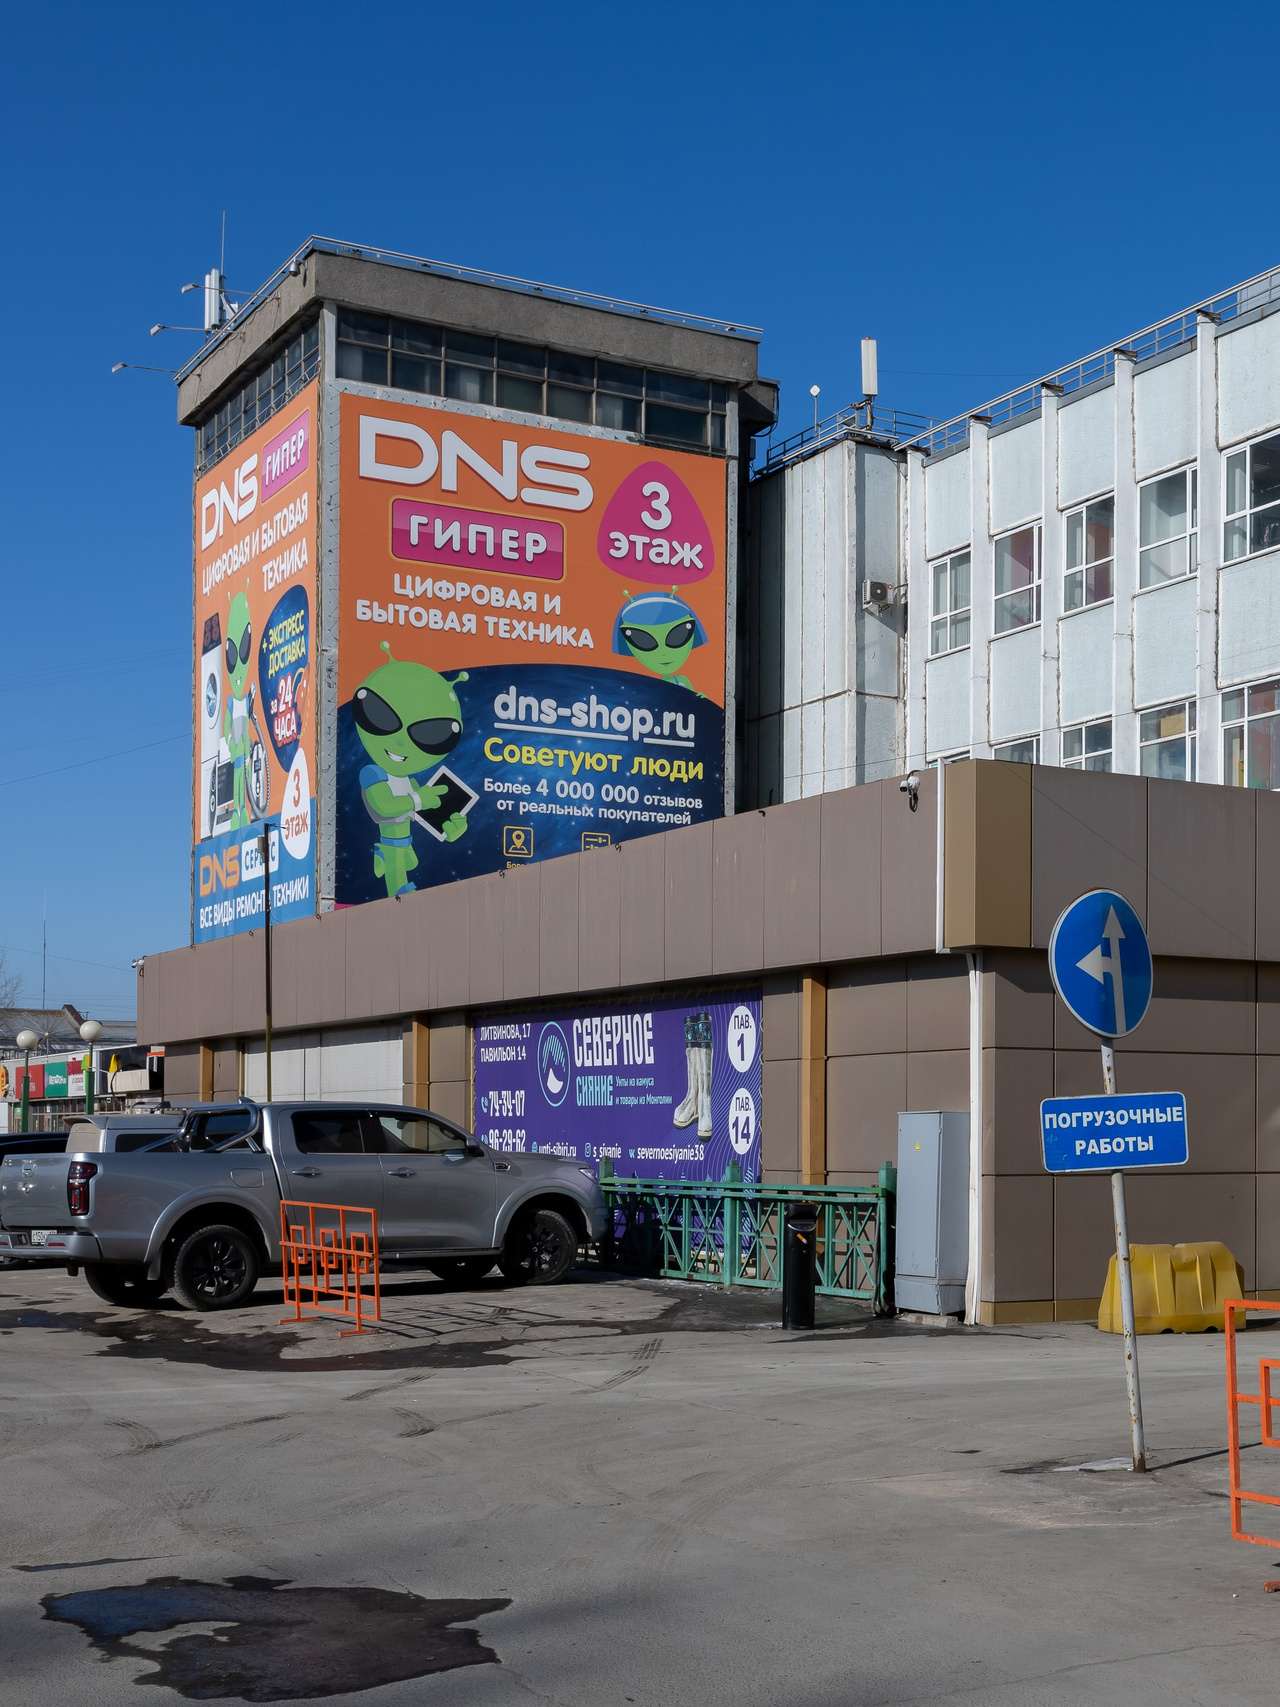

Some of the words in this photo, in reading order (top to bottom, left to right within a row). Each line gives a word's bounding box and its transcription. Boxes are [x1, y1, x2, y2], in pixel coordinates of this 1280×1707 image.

[265, 428, 305, 486] ГИПЕР
[359, 415, 594, 511] DNS
[202, 453, 258, 550] DNS
[640, 481, 672, 530] 3
[202, 534, 250, 596] ЦИФРОВАЯ
[252, 528, 259, 559] И
[261, 492, 308, 552] БЫТОВАЯ
[409, 514, 548, 562] ГИПЕР
[609, 531, 704, 570] этаж
[262, 537, 308, 593] ТЕХНИКА
[393, 573, 538, 613] ЦИФРОВАЯ
[544, 593, 561, 615] И
[268, 610, 305, 650] ЭКСПРЕСС
[356, 600, 477, 632] БЫТОВАЯ
[484, 615, 594, 649] ТЕХНИКА
[268, 635, 306, 679] ДОСТАВКА
[270, 698, 278, 715] за
[278, 675, 292, 712] 24
[493, 685, 695, 741] dns-shop.ru
[275, 711, 297, 743] ЧАСА
[483, 736, 622, 776] Советуют
[632, 756, 704, 783] люди
[293, 768, 301, 808] 3
[484, 777, 531, 796] Более
[535, 778, 549, 797] 4
[555, 781, 595, 800] 000
[601, 783, 639, 804] 000
[643, 794, 703, 809] отзывов
[285, 811, 308, 840] этаж
[496, 799, 516, 811] от
[519, 799, 594, 819] реальных
[599, 805, 691, 825] покупателей
[200, 844, 240, 897] DNS
[200, 905, 212, 929] ВСЕ
[214, 899, 235, 927] ВИДЫ
[272, 875, 309, 908] ТЕХНИКИ
[481, 1024, 522, 1041] ЛИТВИНОВА,
[522, 1023, 531, 1038] 17
[573, 1012, 655, 1068] СЕВЕРНОЕ
[733, 1013, 752, 1030] ПАВ.
[481, 1046, 516, 1062] ПАВИЛЬОН
[517, 1045, 526, 1060] 14
[737, 1034, 745, 1062] 1
[575, 1074, 613, 1106] СИЯНИЕ
[615, 1076, 628, 1087] Унты
[629, 1078, 635, 1086] из
[620, 1096, 638, 1107] товары
[639, 1096, 645, 1104] из
[646, 1093, 672, 1104] Монголии
[489, 1090, 525, 1117] 74-34-07
[735, 1095, 752, 1112] ПАВ.
[1044, 1106, 1183, 1129] ПОГРУЗОЧНЫЕ
[489, 1129, 526, 1152] 96-29-62
[732, 1116, 751, 1145] 14
[1075, 1135, 1154, 1156] РАБОТЫ
[637, 1144, 704, 1164] severnoesiyanie38
